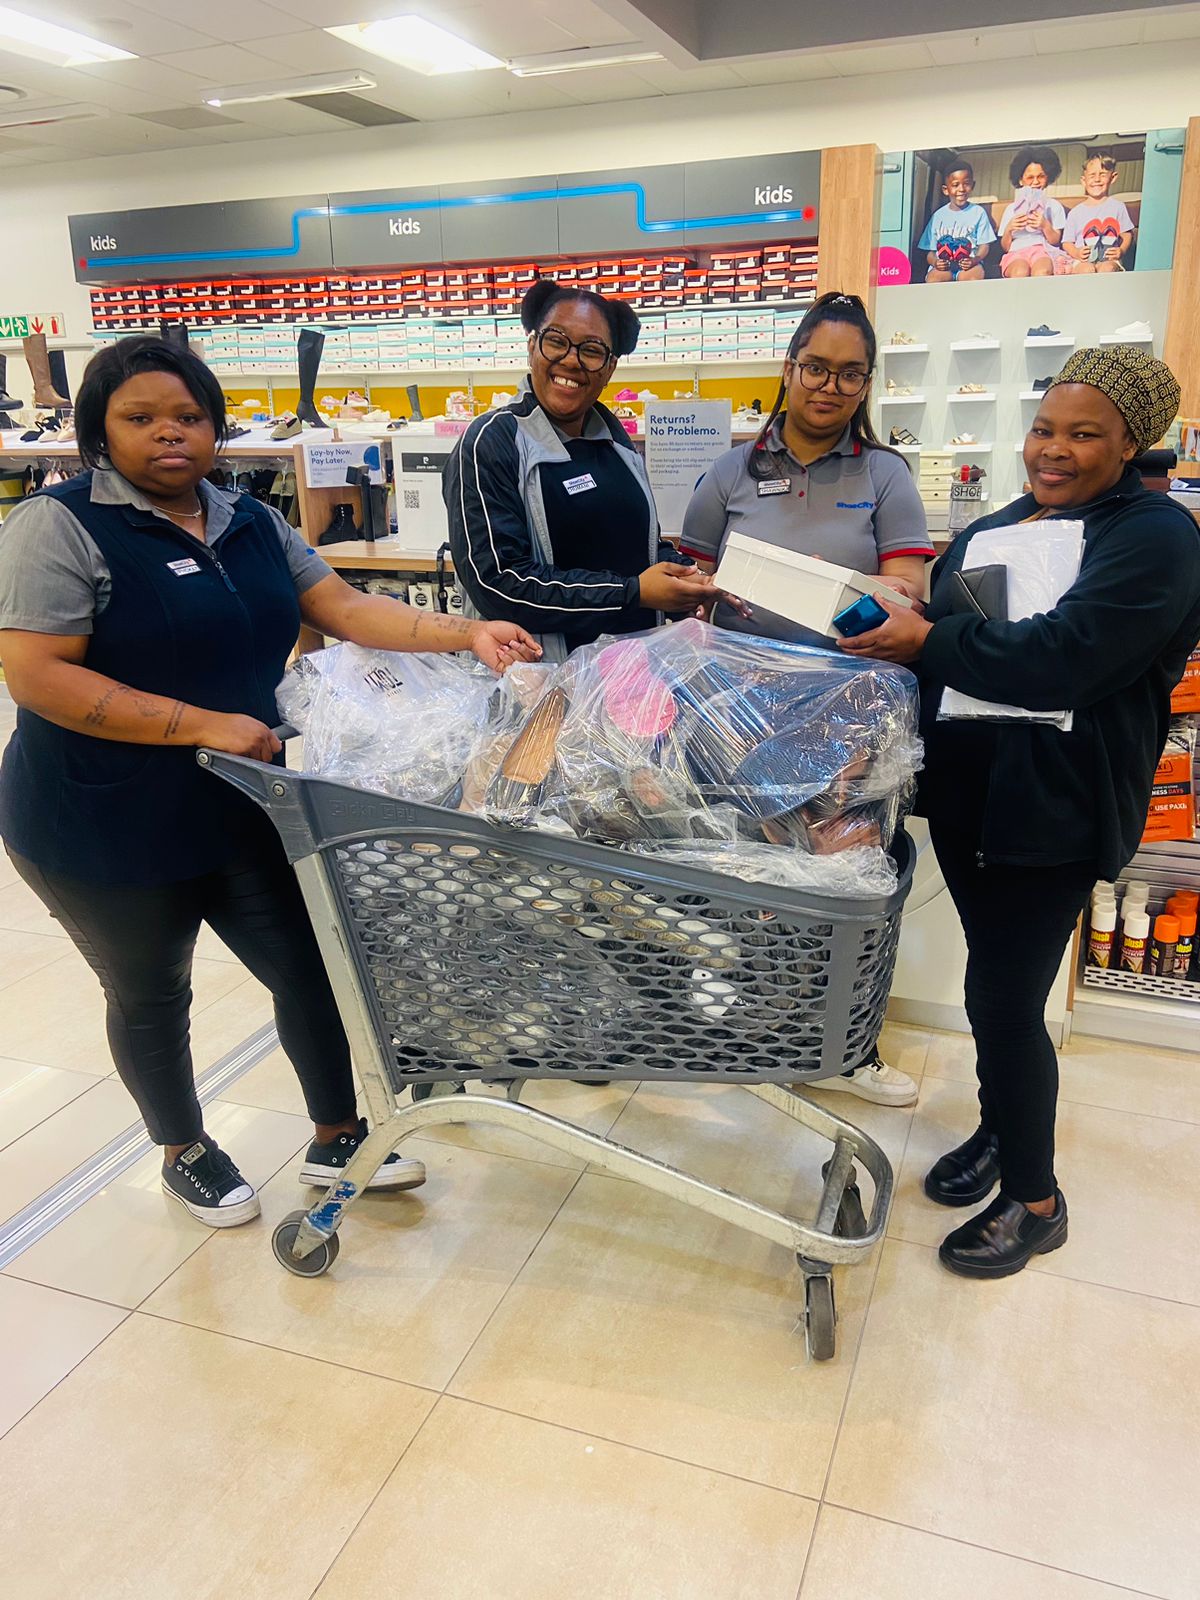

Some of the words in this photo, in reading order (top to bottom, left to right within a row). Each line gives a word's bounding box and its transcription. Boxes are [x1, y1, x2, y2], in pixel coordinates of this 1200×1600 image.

[755, 185, 793, 205] kids
[389, 218, 421, 235] kids
[90, 235, 117, 251] kids
[880, 267, 900, 276] Kids
[650, 414, 696, 424] Returns?
[650, 427, 665, 436] No
[667, 426, 720, 436] Problemo.
[310, 449, 335, 457] Lay-by
[311, 457, 324, 465] Pay
[835, 501, 874, 510] ShoeCity
[1124, 937, 1144, 949] plush
